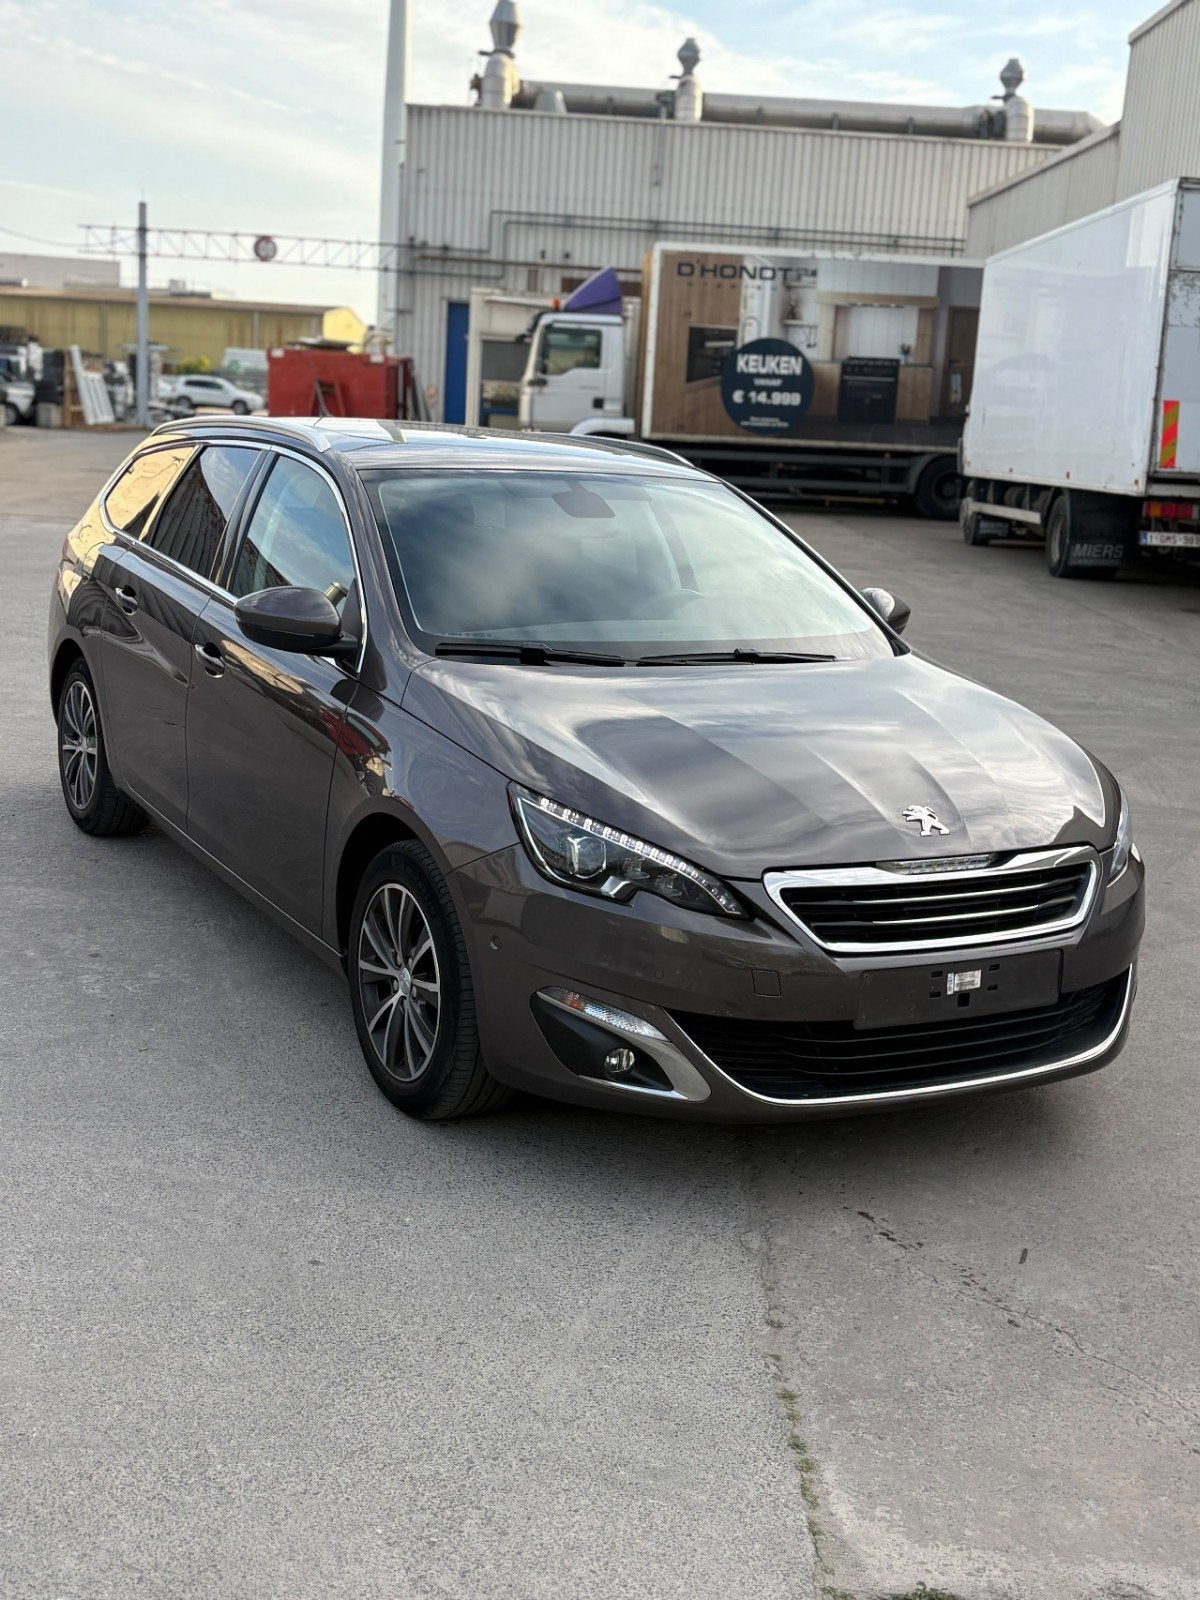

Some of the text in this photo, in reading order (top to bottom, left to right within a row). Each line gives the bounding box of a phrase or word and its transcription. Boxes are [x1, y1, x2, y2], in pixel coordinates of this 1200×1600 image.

[677, 259, 792, 281] D'HONDT
[736, 354, 802, 376] KEUKEN
[1072, 543, 1124, 559] MIERS
